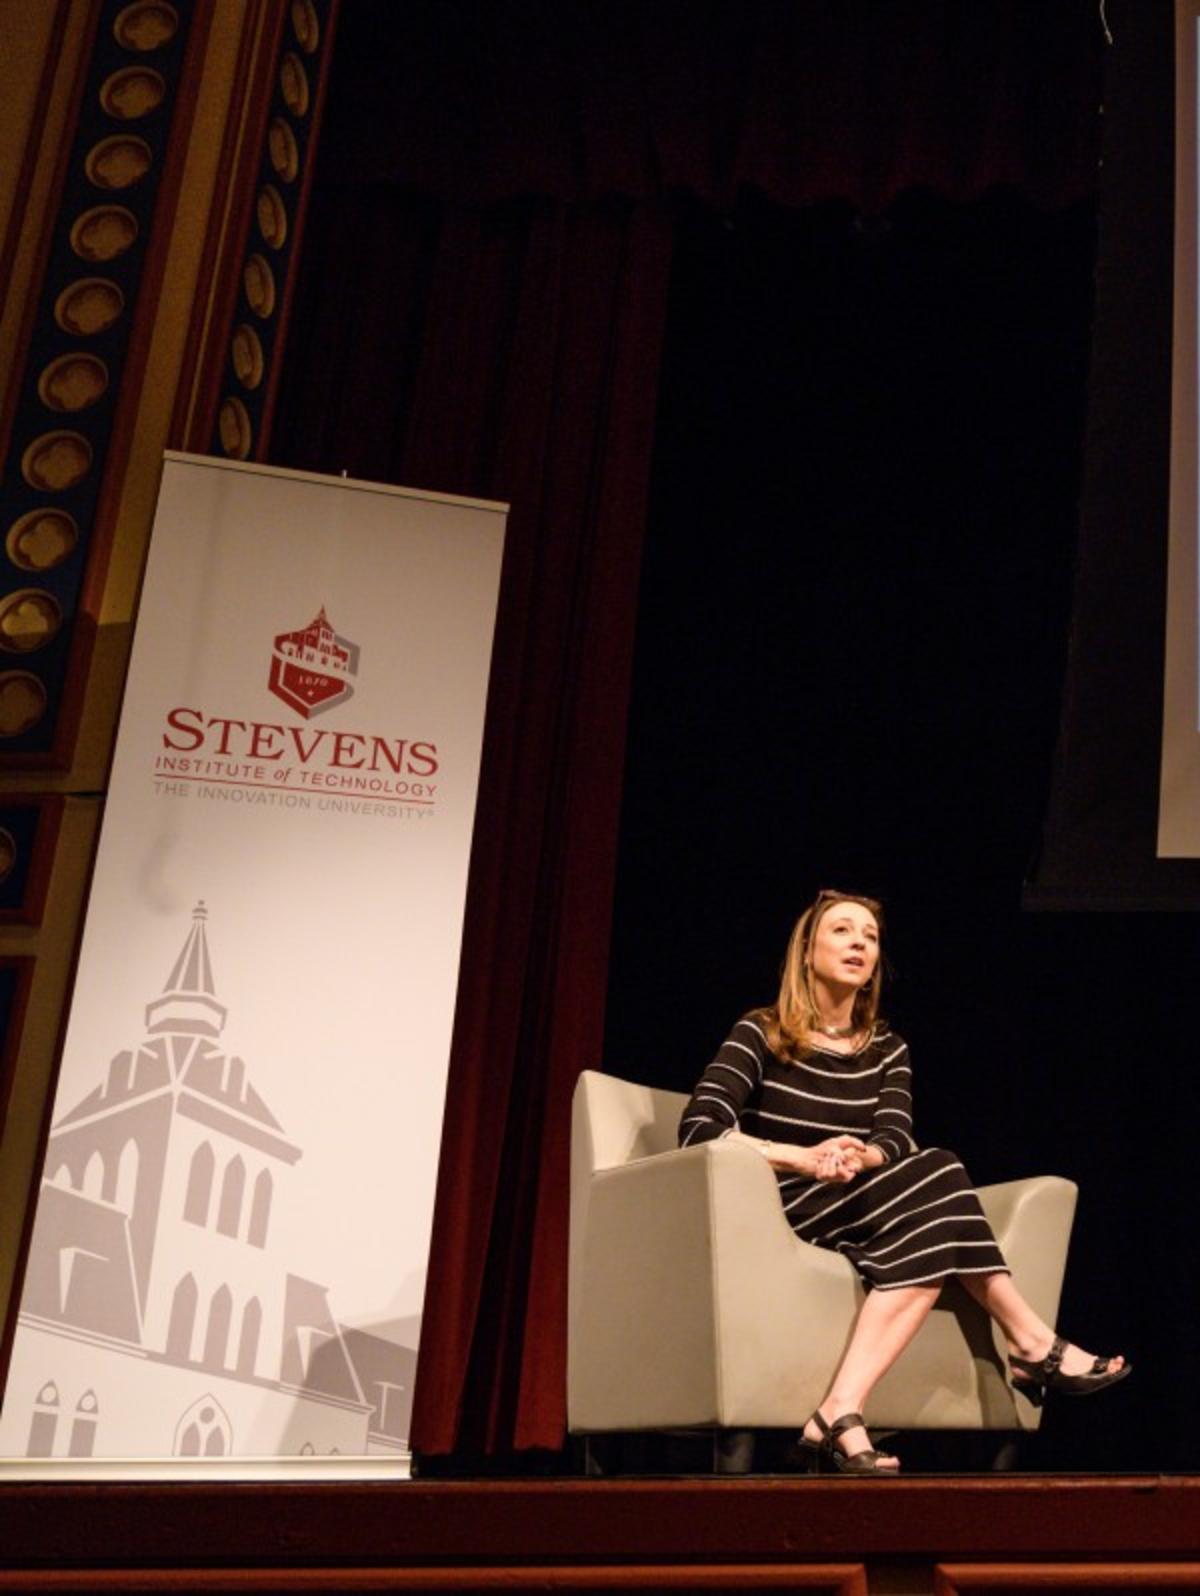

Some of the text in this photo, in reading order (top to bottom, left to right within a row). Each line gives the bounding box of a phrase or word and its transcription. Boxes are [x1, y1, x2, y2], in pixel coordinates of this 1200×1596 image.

[162, 707, 439, 777] STEVENS
[153, 781, 191, 798] THE
[197, 786, 312, 810] INNOVATION
[155, 756, 438, 798] INSTITUTE of TECHNOLOGY
